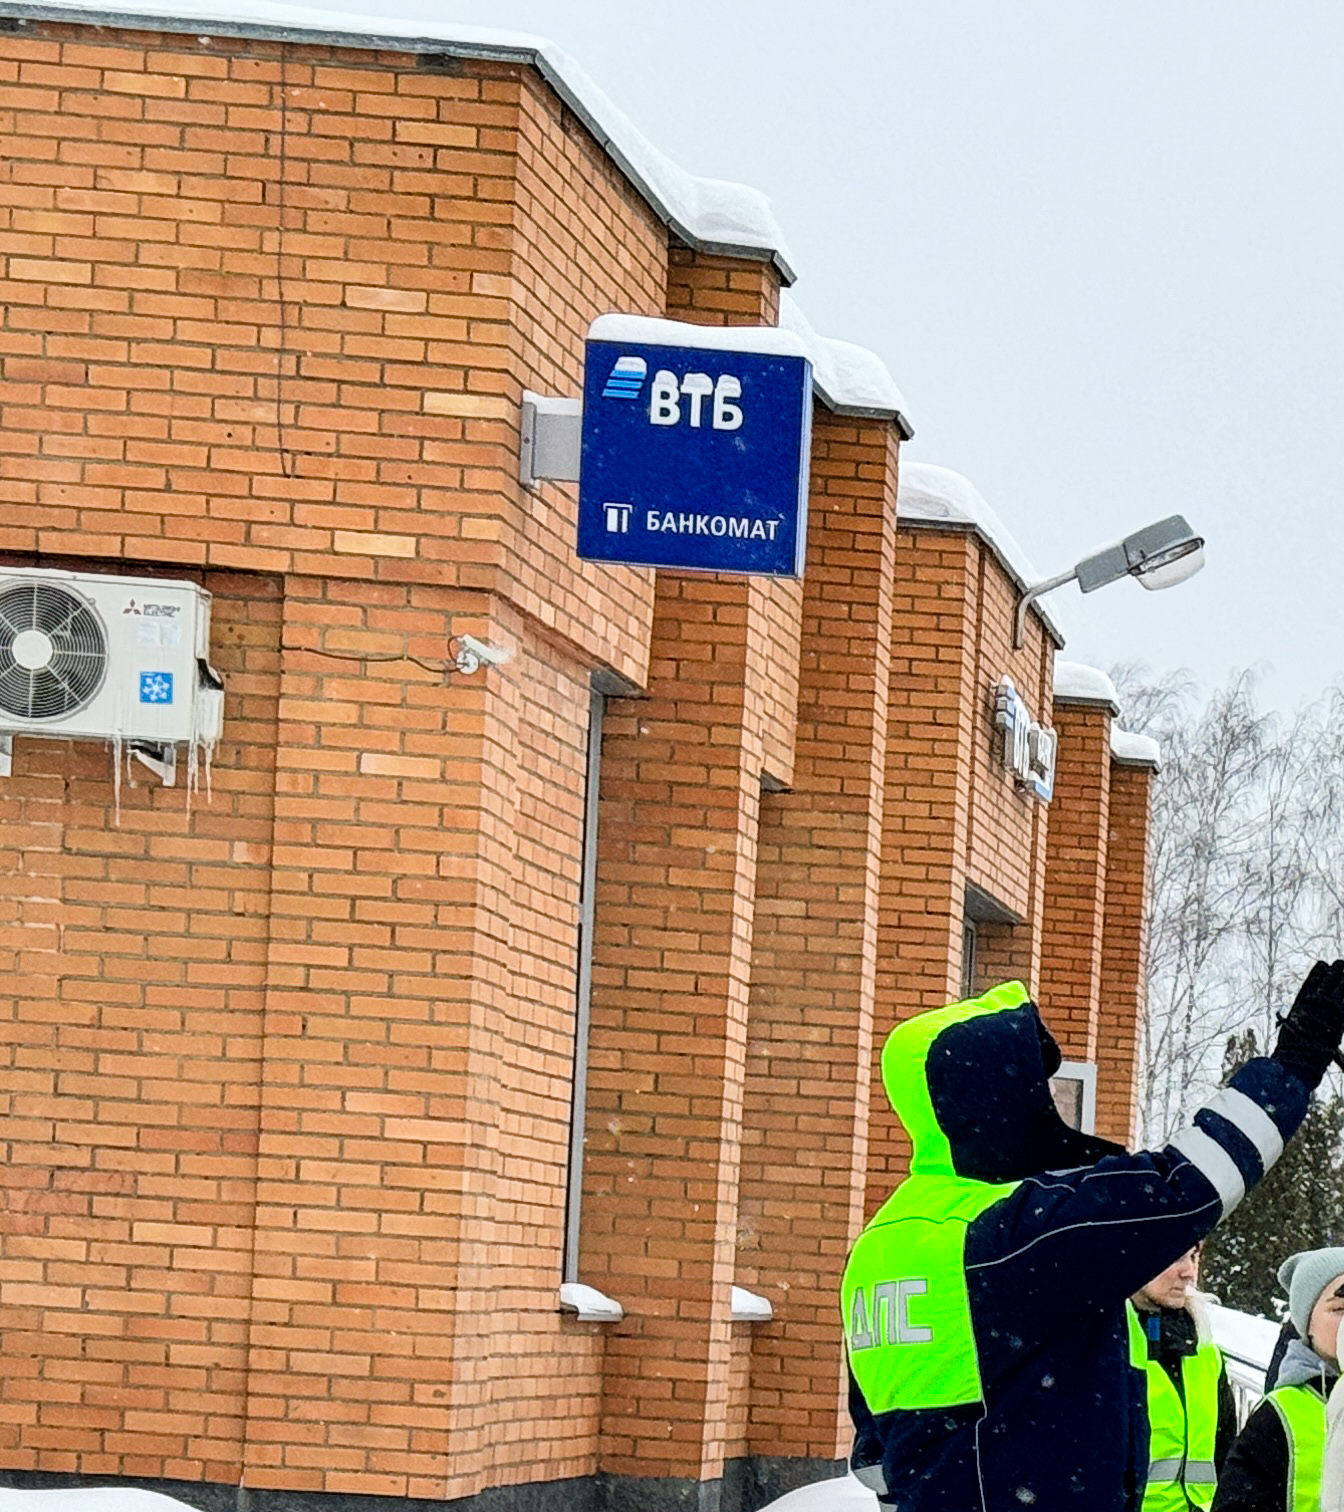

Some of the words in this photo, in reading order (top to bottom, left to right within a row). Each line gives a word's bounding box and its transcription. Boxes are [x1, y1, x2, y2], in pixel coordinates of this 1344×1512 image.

[650, 371, 743, 430] ВТБ
[646, 510, 779, 540] БАНКОМАТ
[851, 1278, 933, 1351] ДПС
